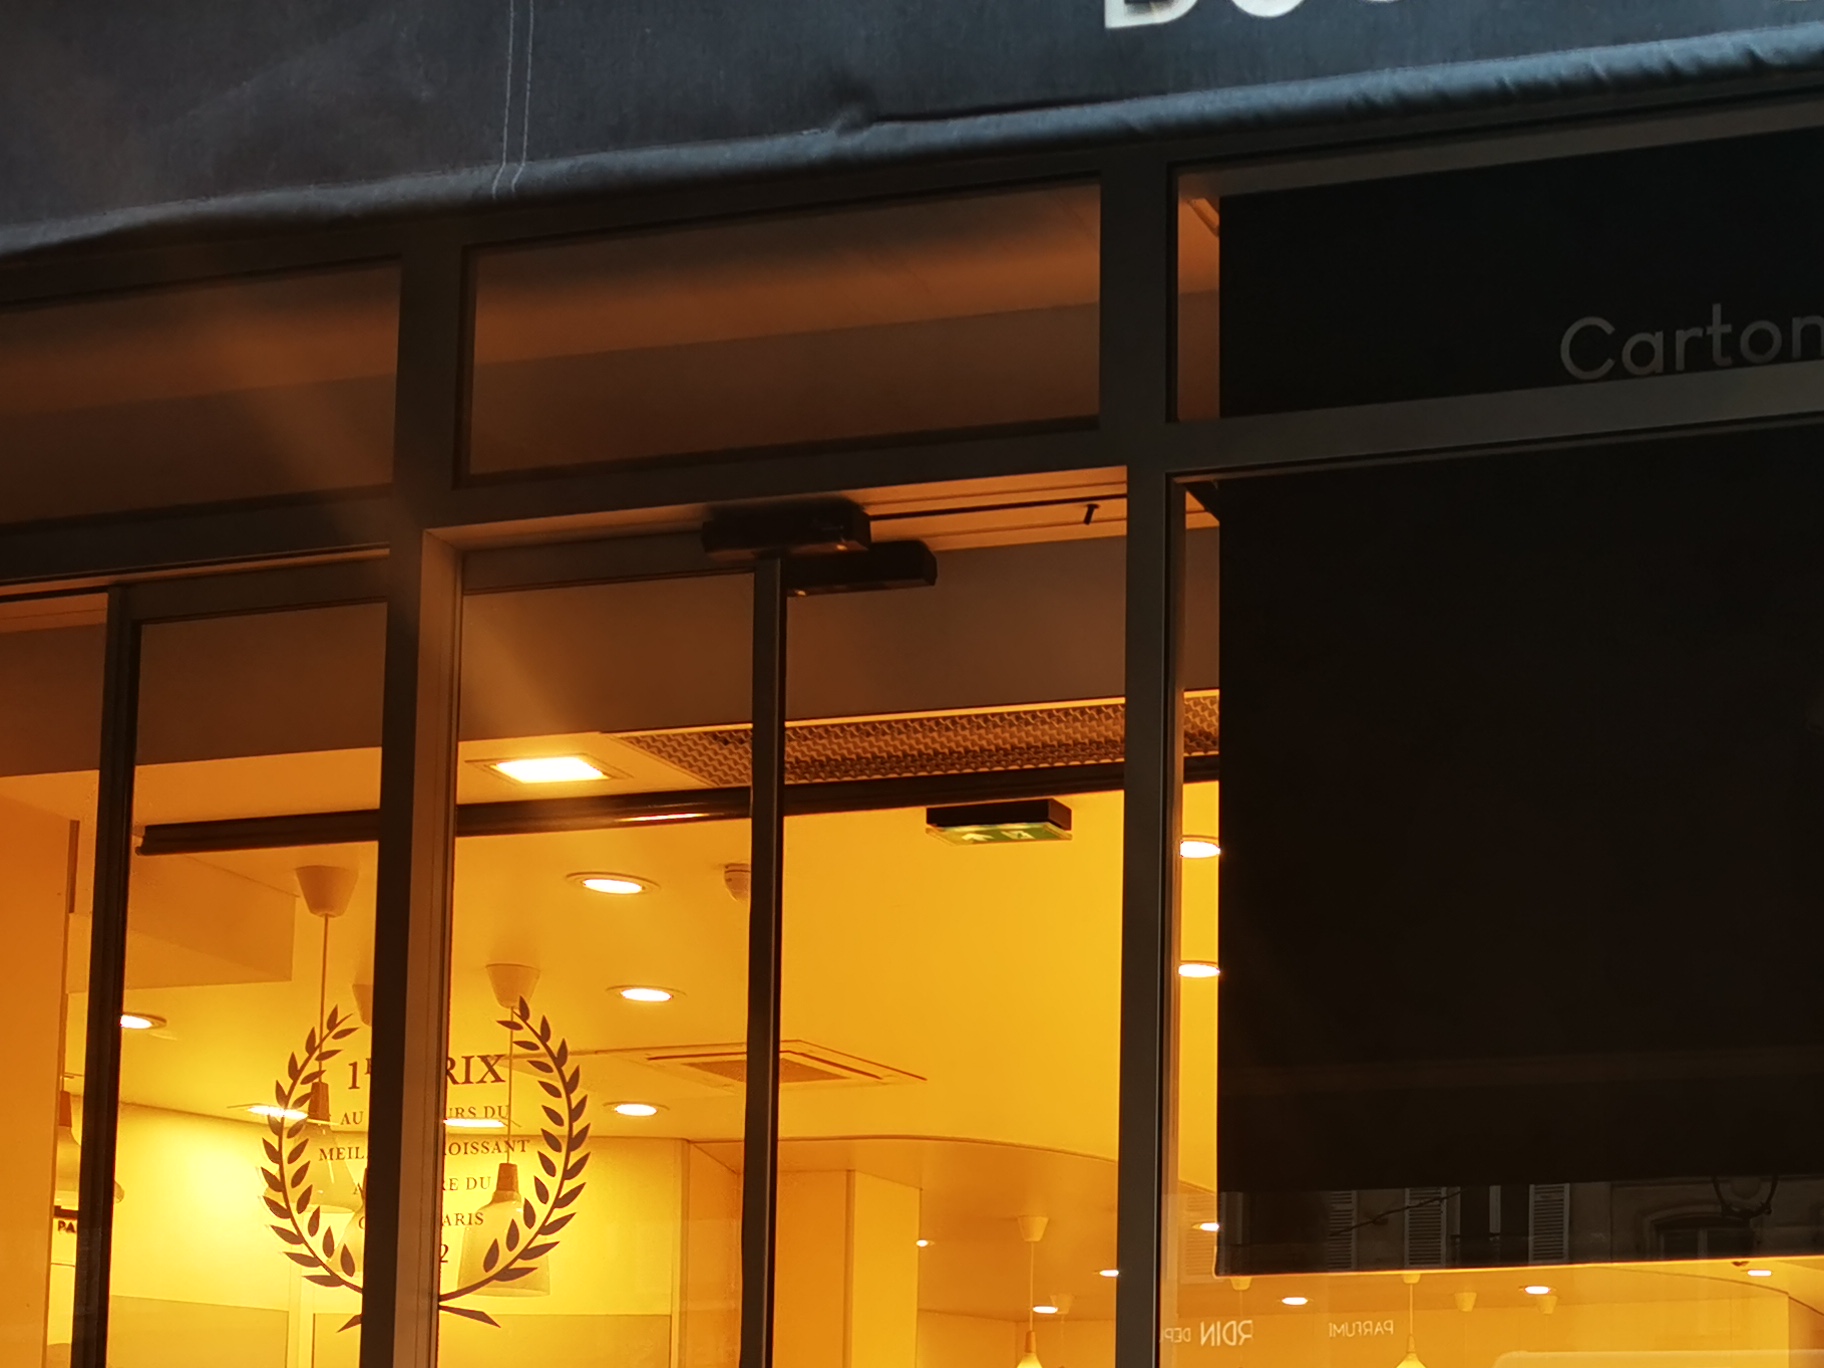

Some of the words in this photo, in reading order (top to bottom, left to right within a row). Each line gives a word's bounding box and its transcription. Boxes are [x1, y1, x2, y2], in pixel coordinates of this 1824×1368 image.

[446, 1054, 506, 1085] RIX
[319, 1147, 367, 1161] MEIL
[444, 1139, 531, 1155] OISSANT
[442, 1212, 484, 1226] ARIS
